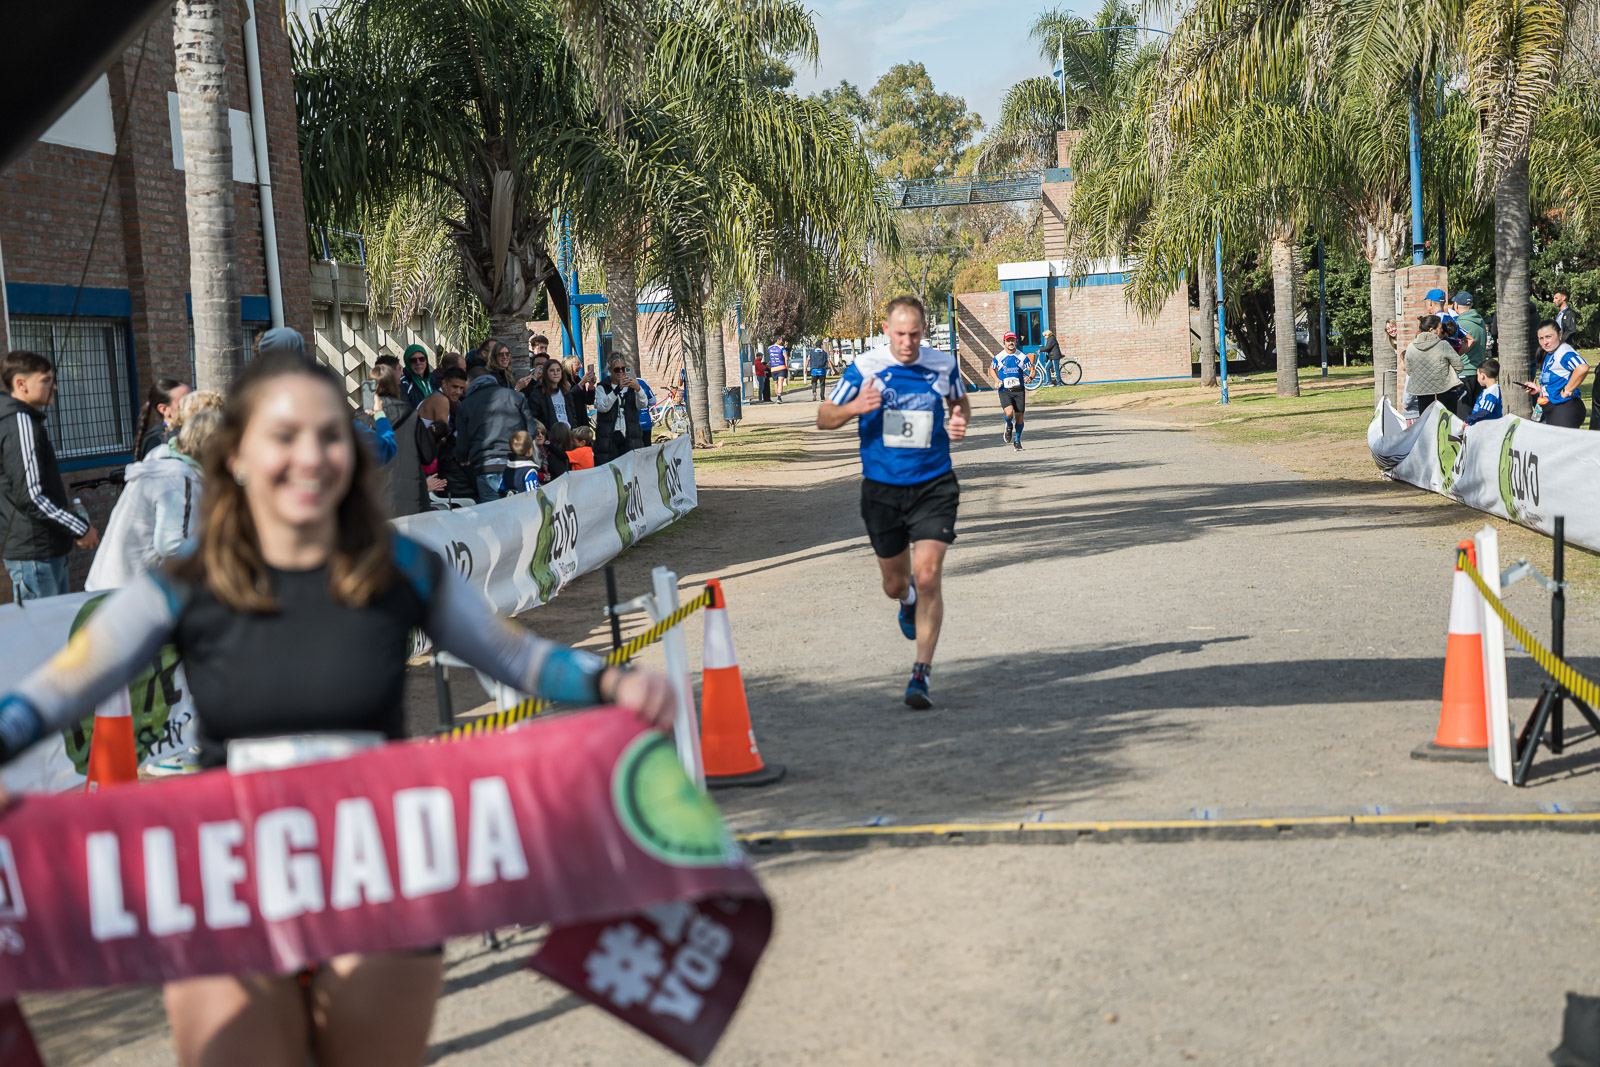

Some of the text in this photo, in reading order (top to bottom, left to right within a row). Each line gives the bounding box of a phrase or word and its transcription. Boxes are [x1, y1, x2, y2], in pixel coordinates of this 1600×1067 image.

[902, 422, 914, 438] 8
[86, 776, 529, 940] LLEGADA
[649, 914, 733, 1024] VOS
